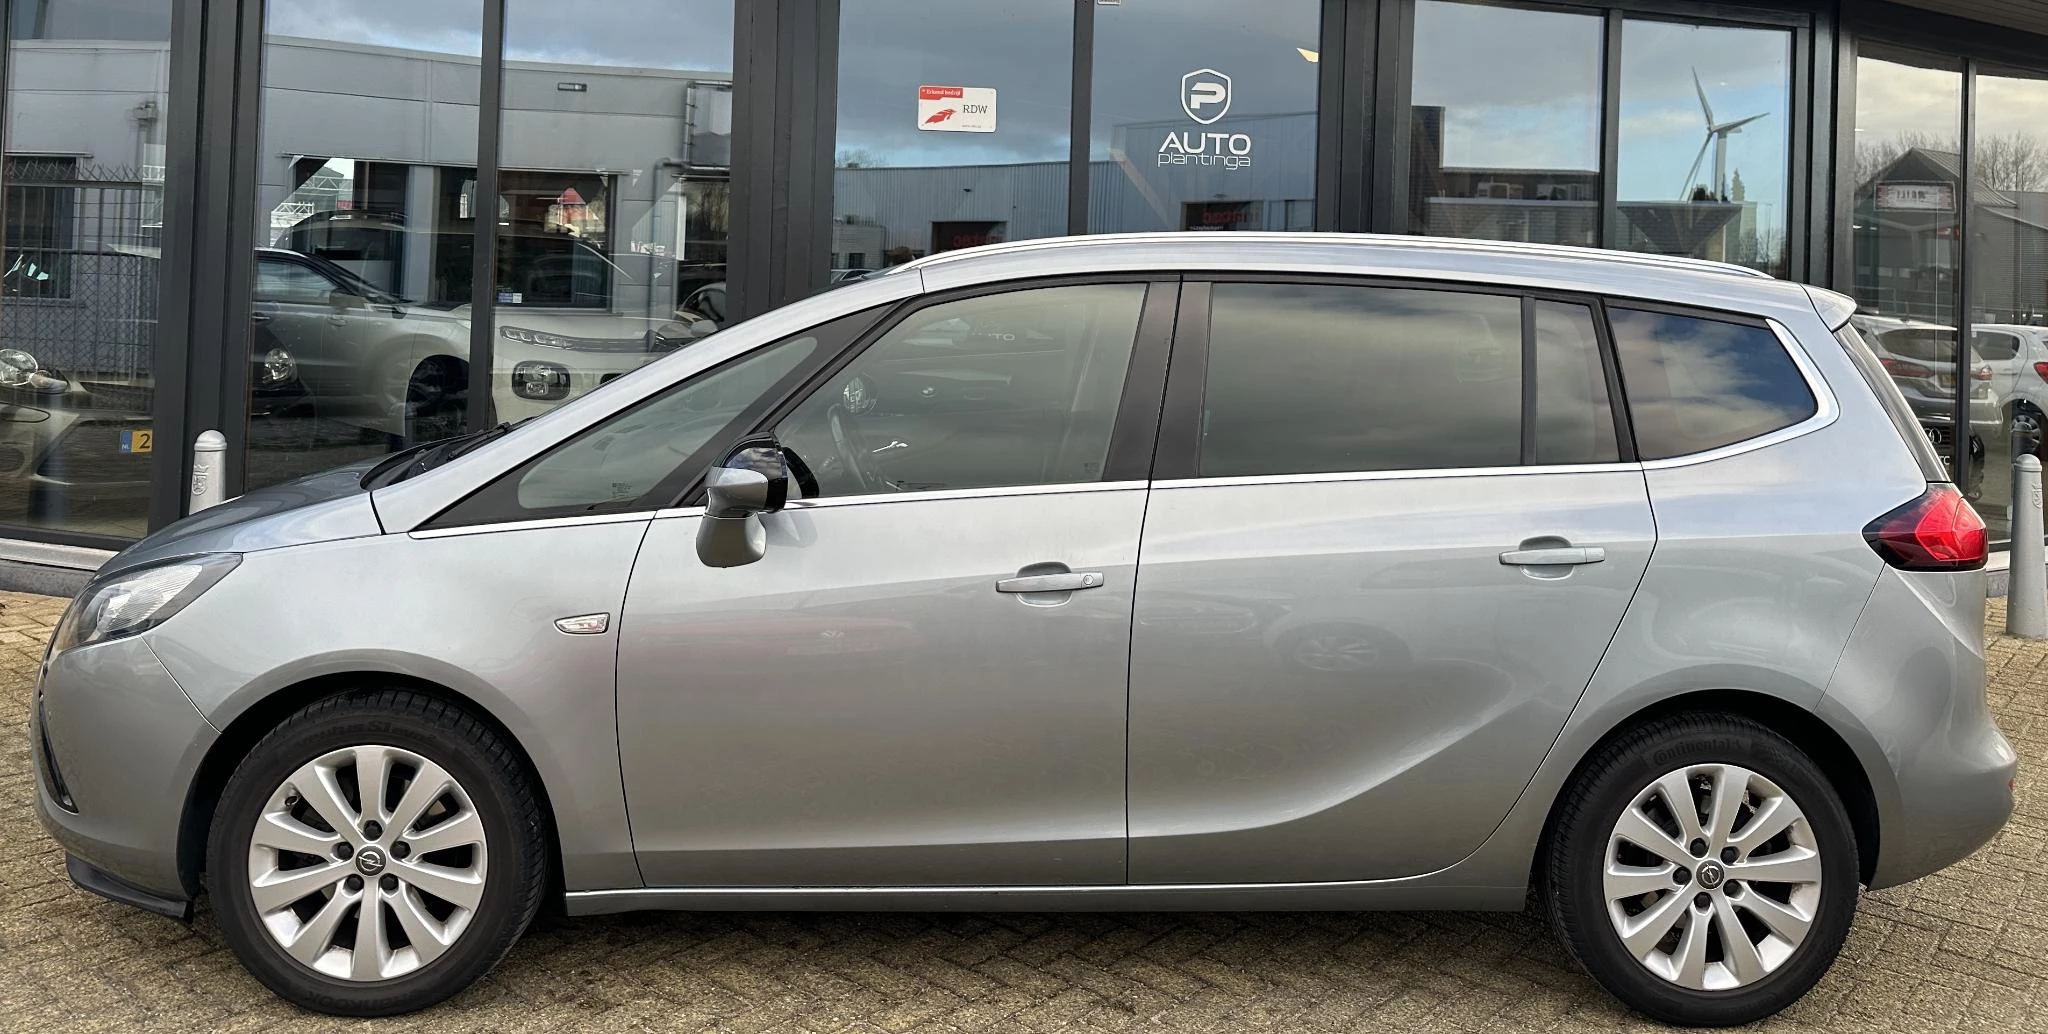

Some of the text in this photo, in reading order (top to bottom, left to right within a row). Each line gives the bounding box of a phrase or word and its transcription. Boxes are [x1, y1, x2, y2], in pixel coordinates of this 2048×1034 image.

[963, 104, 988, 114] RDW
[1159, 131, 1251, 155] AUTO
[1158, 152, 1251, 170] plantinga
[139, 433, 151, 450] 2
